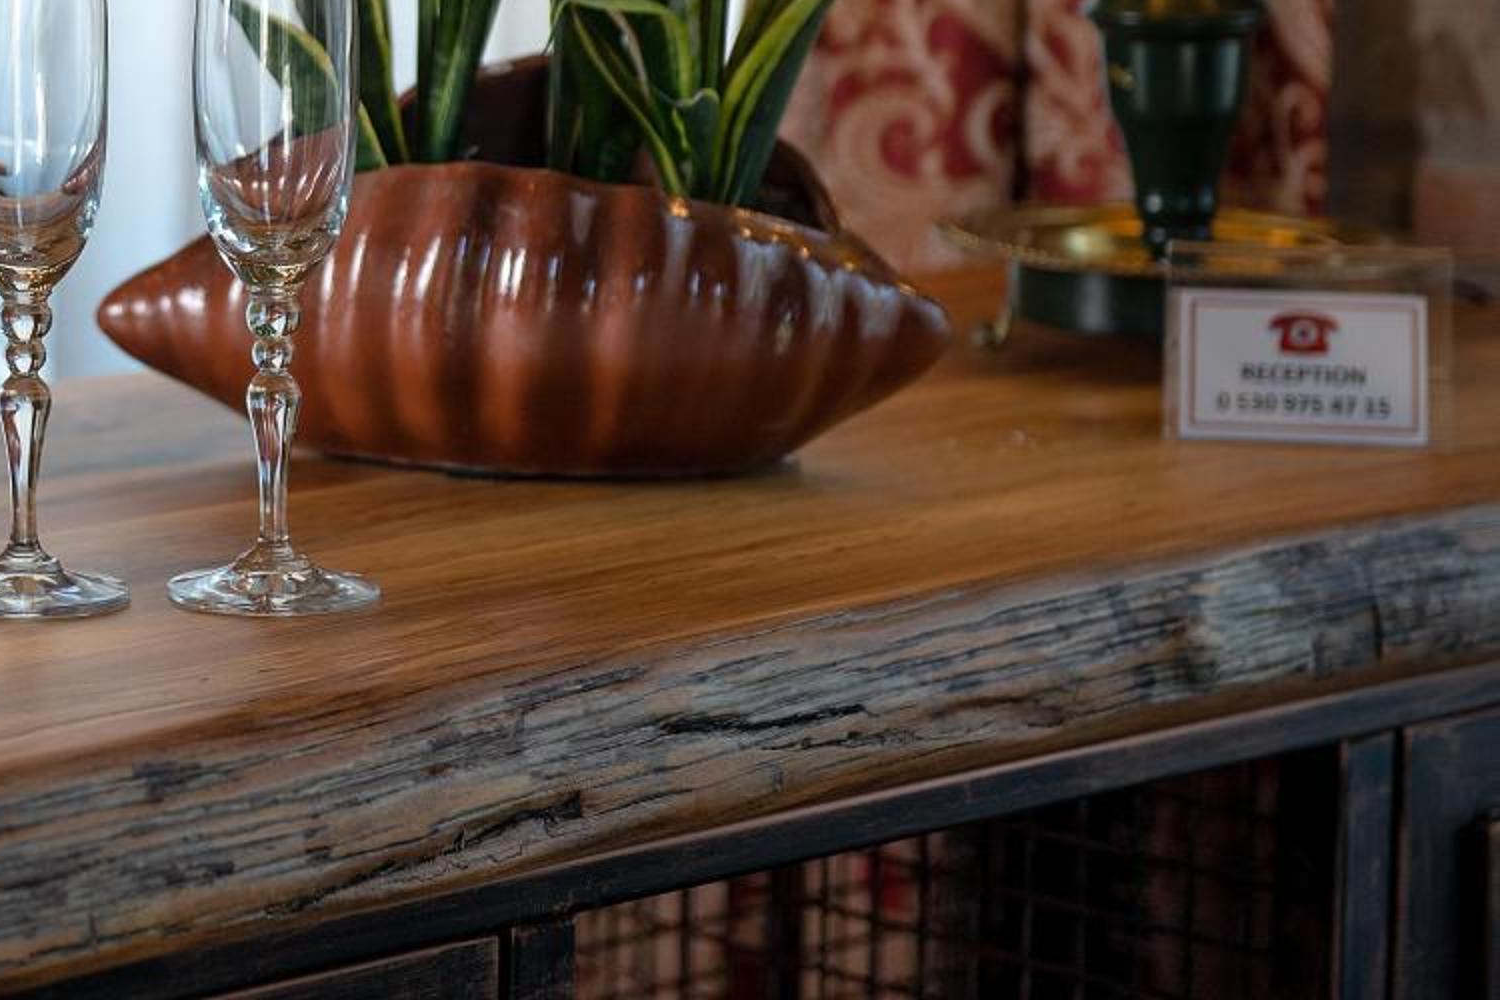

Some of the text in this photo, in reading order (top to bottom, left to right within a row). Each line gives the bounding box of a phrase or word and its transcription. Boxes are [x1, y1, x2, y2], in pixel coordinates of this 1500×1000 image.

[1241, 362, 1367, 385] RECEPTION
[1217, 392, 1391, 418] 0 530 975 47 15
